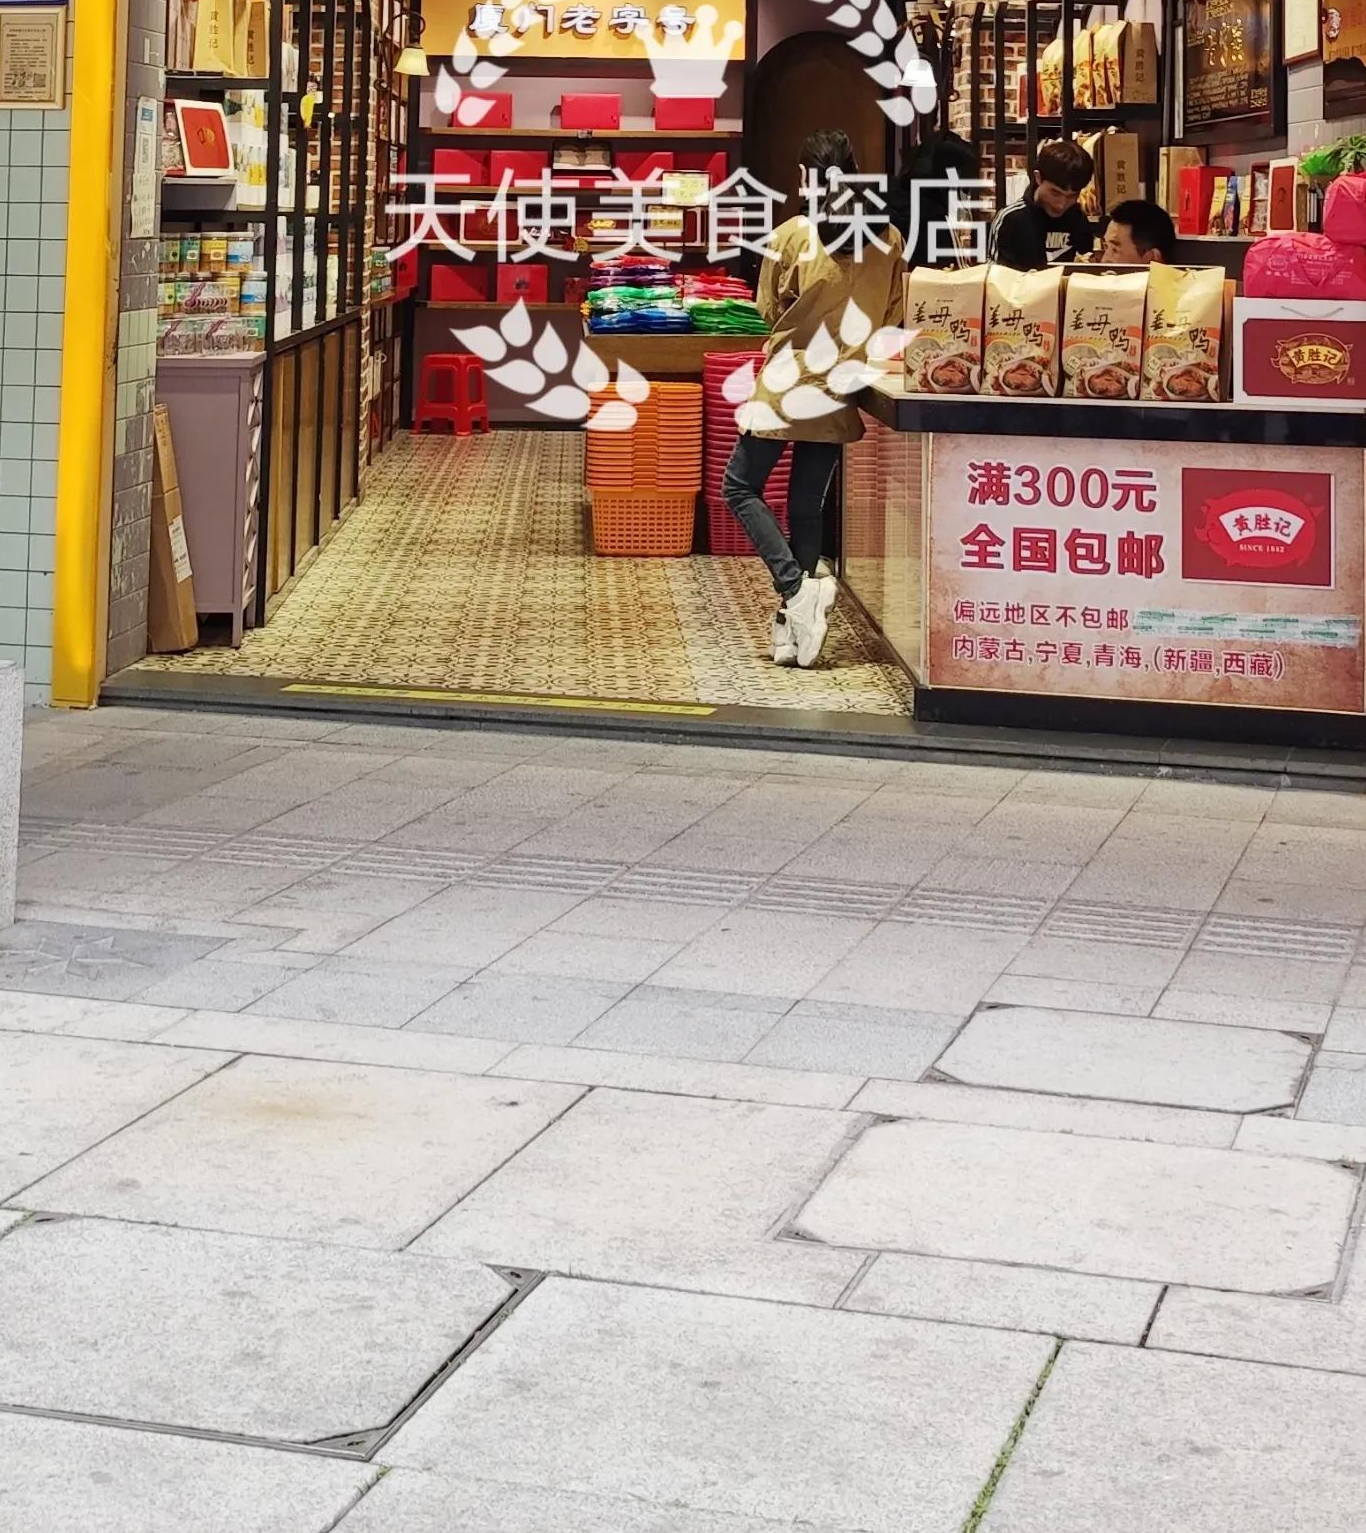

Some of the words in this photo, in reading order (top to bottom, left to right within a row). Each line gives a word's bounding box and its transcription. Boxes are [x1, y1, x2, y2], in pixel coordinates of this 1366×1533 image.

[469, 2, 696, 36] 厦门老字号
[1045, 232, 1071, 248] NIKE
[1292, 348, 1339, 366] 黄胜记
[967, 462, 1157, 513] 满300元
[1233, 513, 1291, 537] 黄胜记
[960, 523, 1165, 579] 全国包邮
[1239, 544, 1264, 552] SINCE
[953, 599, 1129, 631] 偏远地区不包邮
